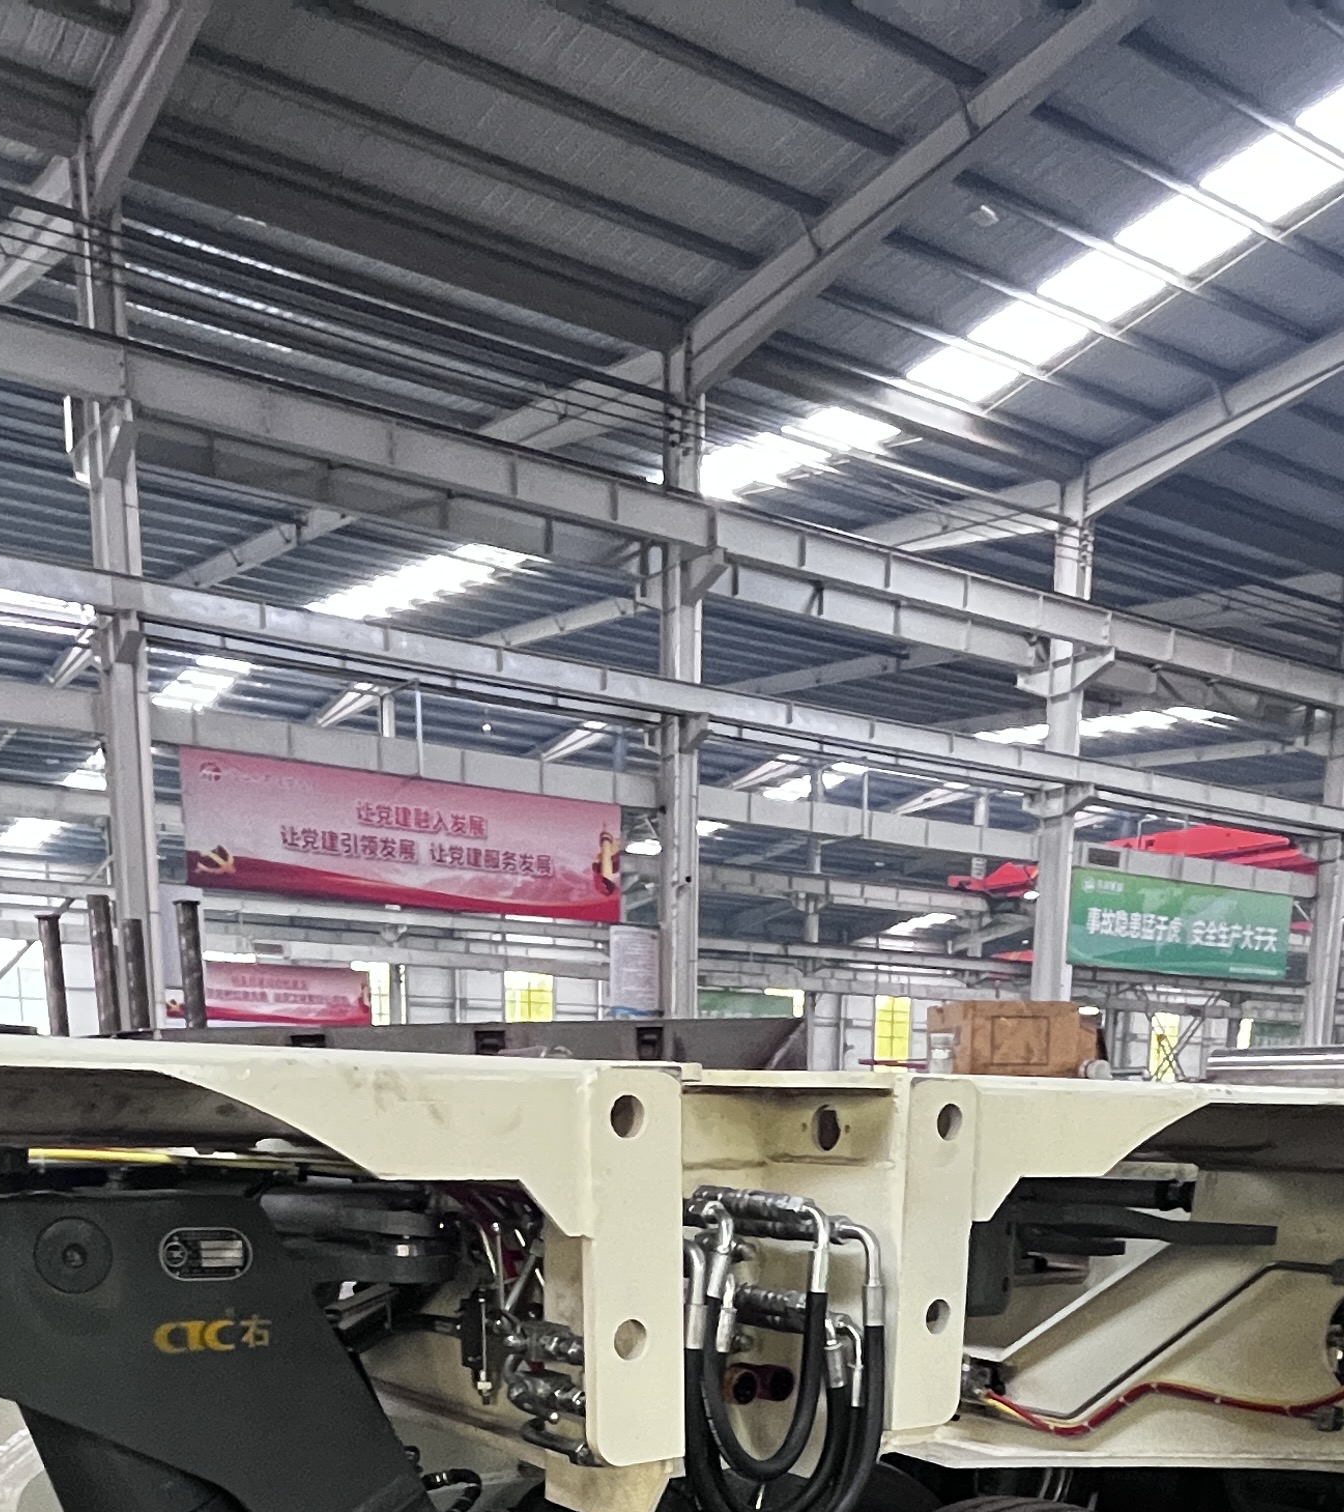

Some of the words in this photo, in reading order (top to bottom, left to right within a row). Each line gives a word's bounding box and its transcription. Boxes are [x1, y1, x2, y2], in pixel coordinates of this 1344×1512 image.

[357, 801, 487, 837] 让党建融入发展
[281, 825, 417, 861] 让党建引领发展
[429, 843, 552, 875] 让党建服务发展
[1190, 920, 1278, 952] 安全生产大于天
